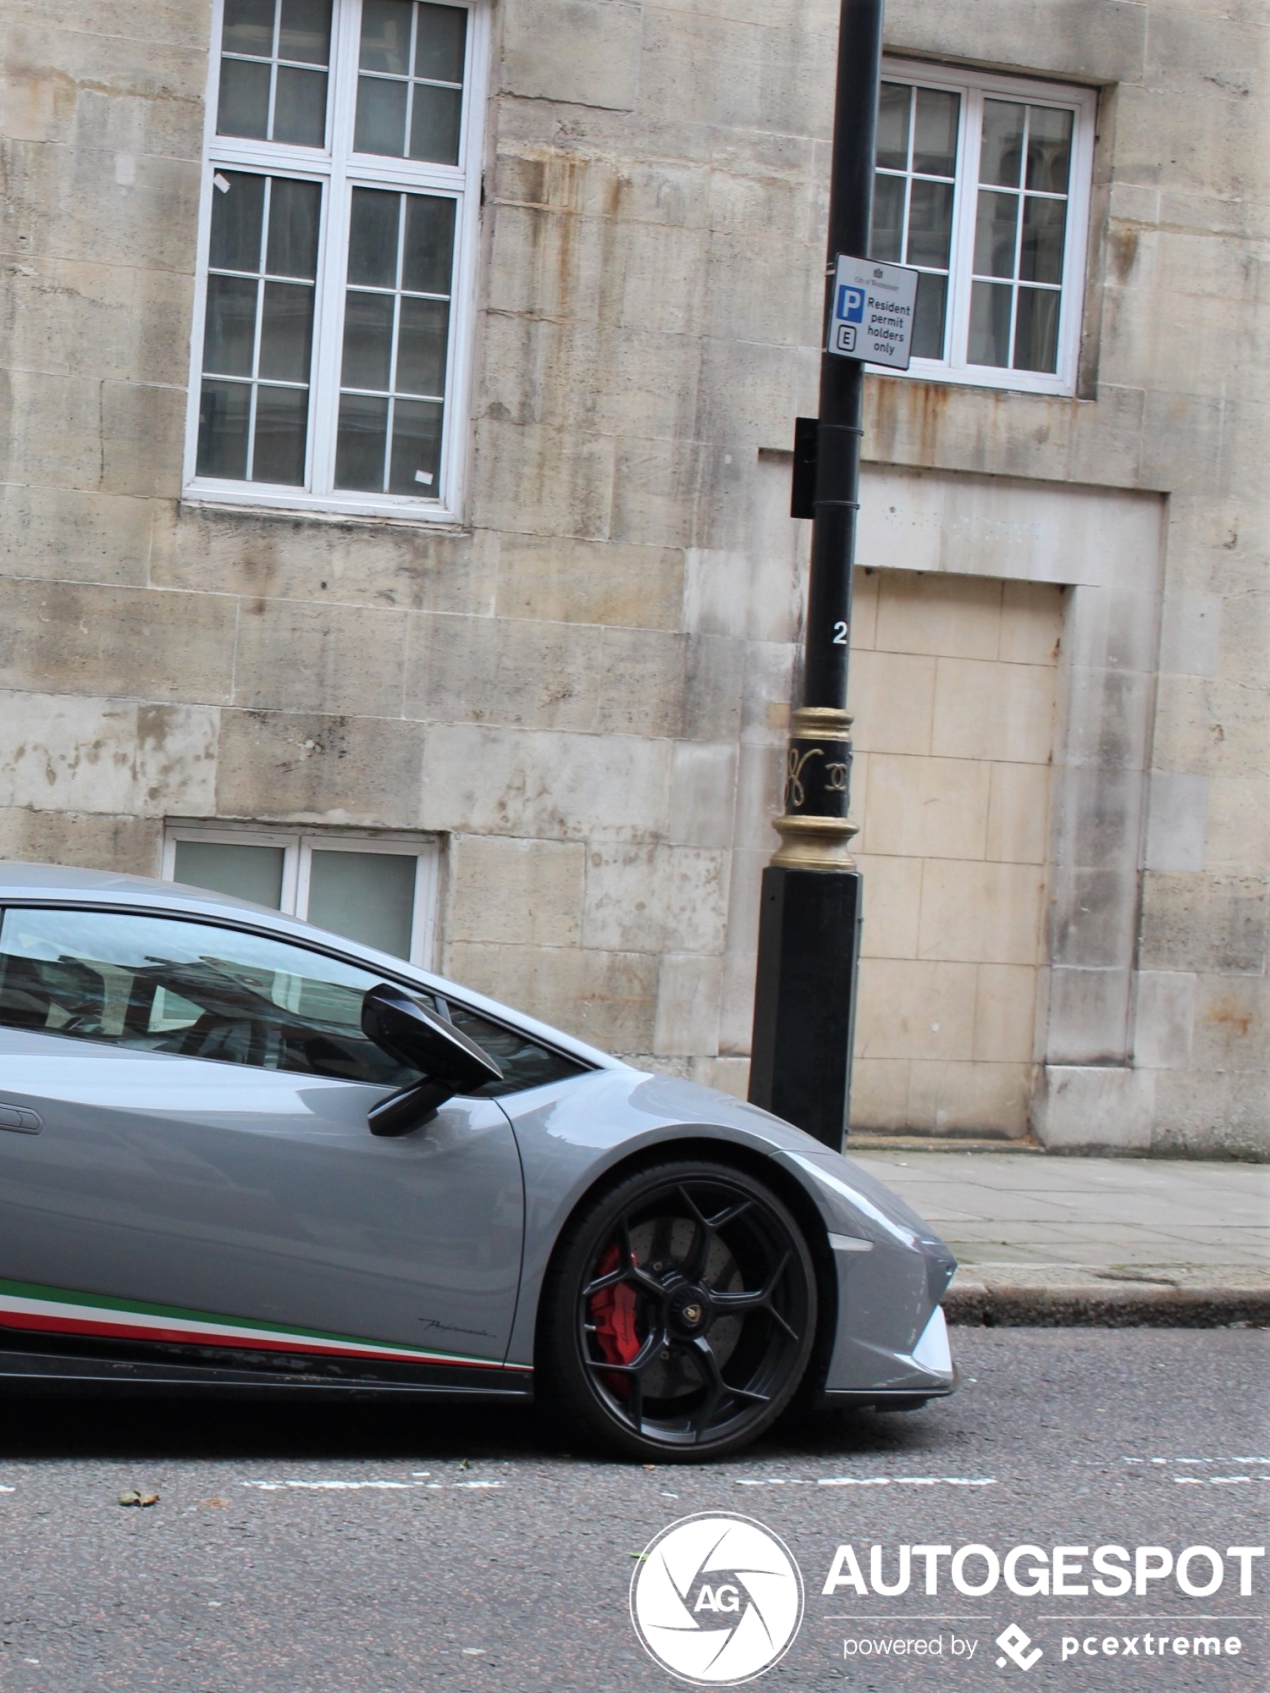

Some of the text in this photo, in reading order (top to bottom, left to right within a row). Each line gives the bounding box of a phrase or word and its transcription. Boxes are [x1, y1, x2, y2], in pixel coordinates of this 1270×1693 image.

[842, 290, 861, 317] P
[867, 297, 911, 316] Resident
[871, 314, 903, 328] permit
[843, 331, 851, 345] E
[867, 325, 904, 342] holders
[874, 342, 895, 356] only
[833, 621, 847, 645] 2
